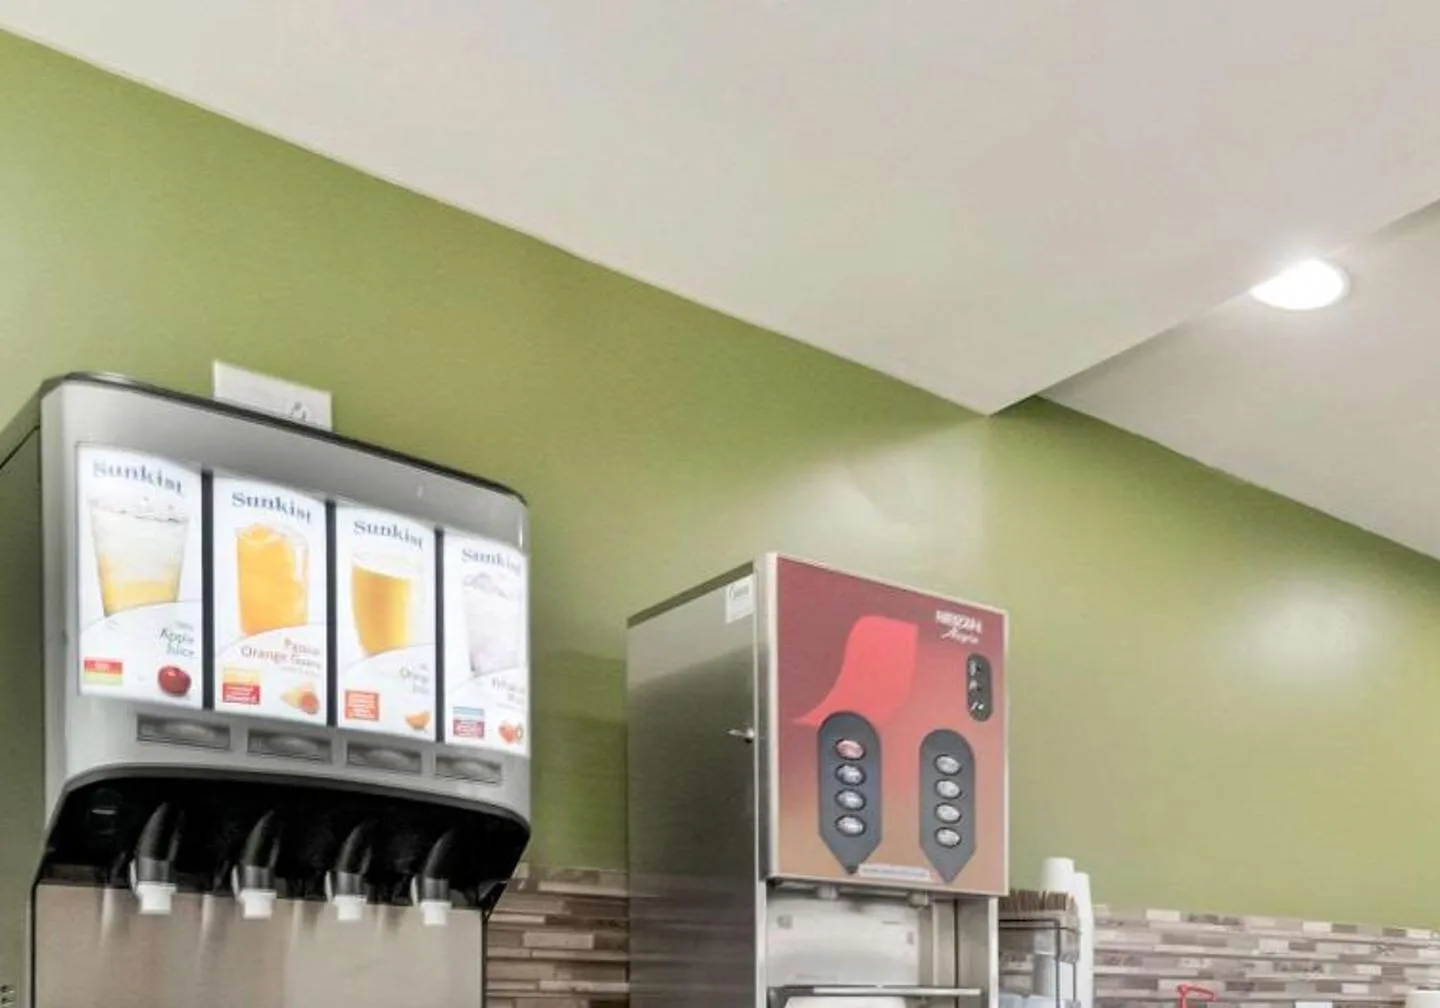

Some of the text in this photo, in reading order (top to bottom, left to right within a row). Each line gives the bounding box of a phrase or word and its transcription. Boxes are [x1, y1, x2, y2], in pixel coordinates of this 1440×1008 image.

[93, 460, 183, 496] Sunkist
[231, 491, 311, 523] Sunkist
[353, 519, 424, 551] Sunkist
[461, 547, 522, 574] Sunkist
